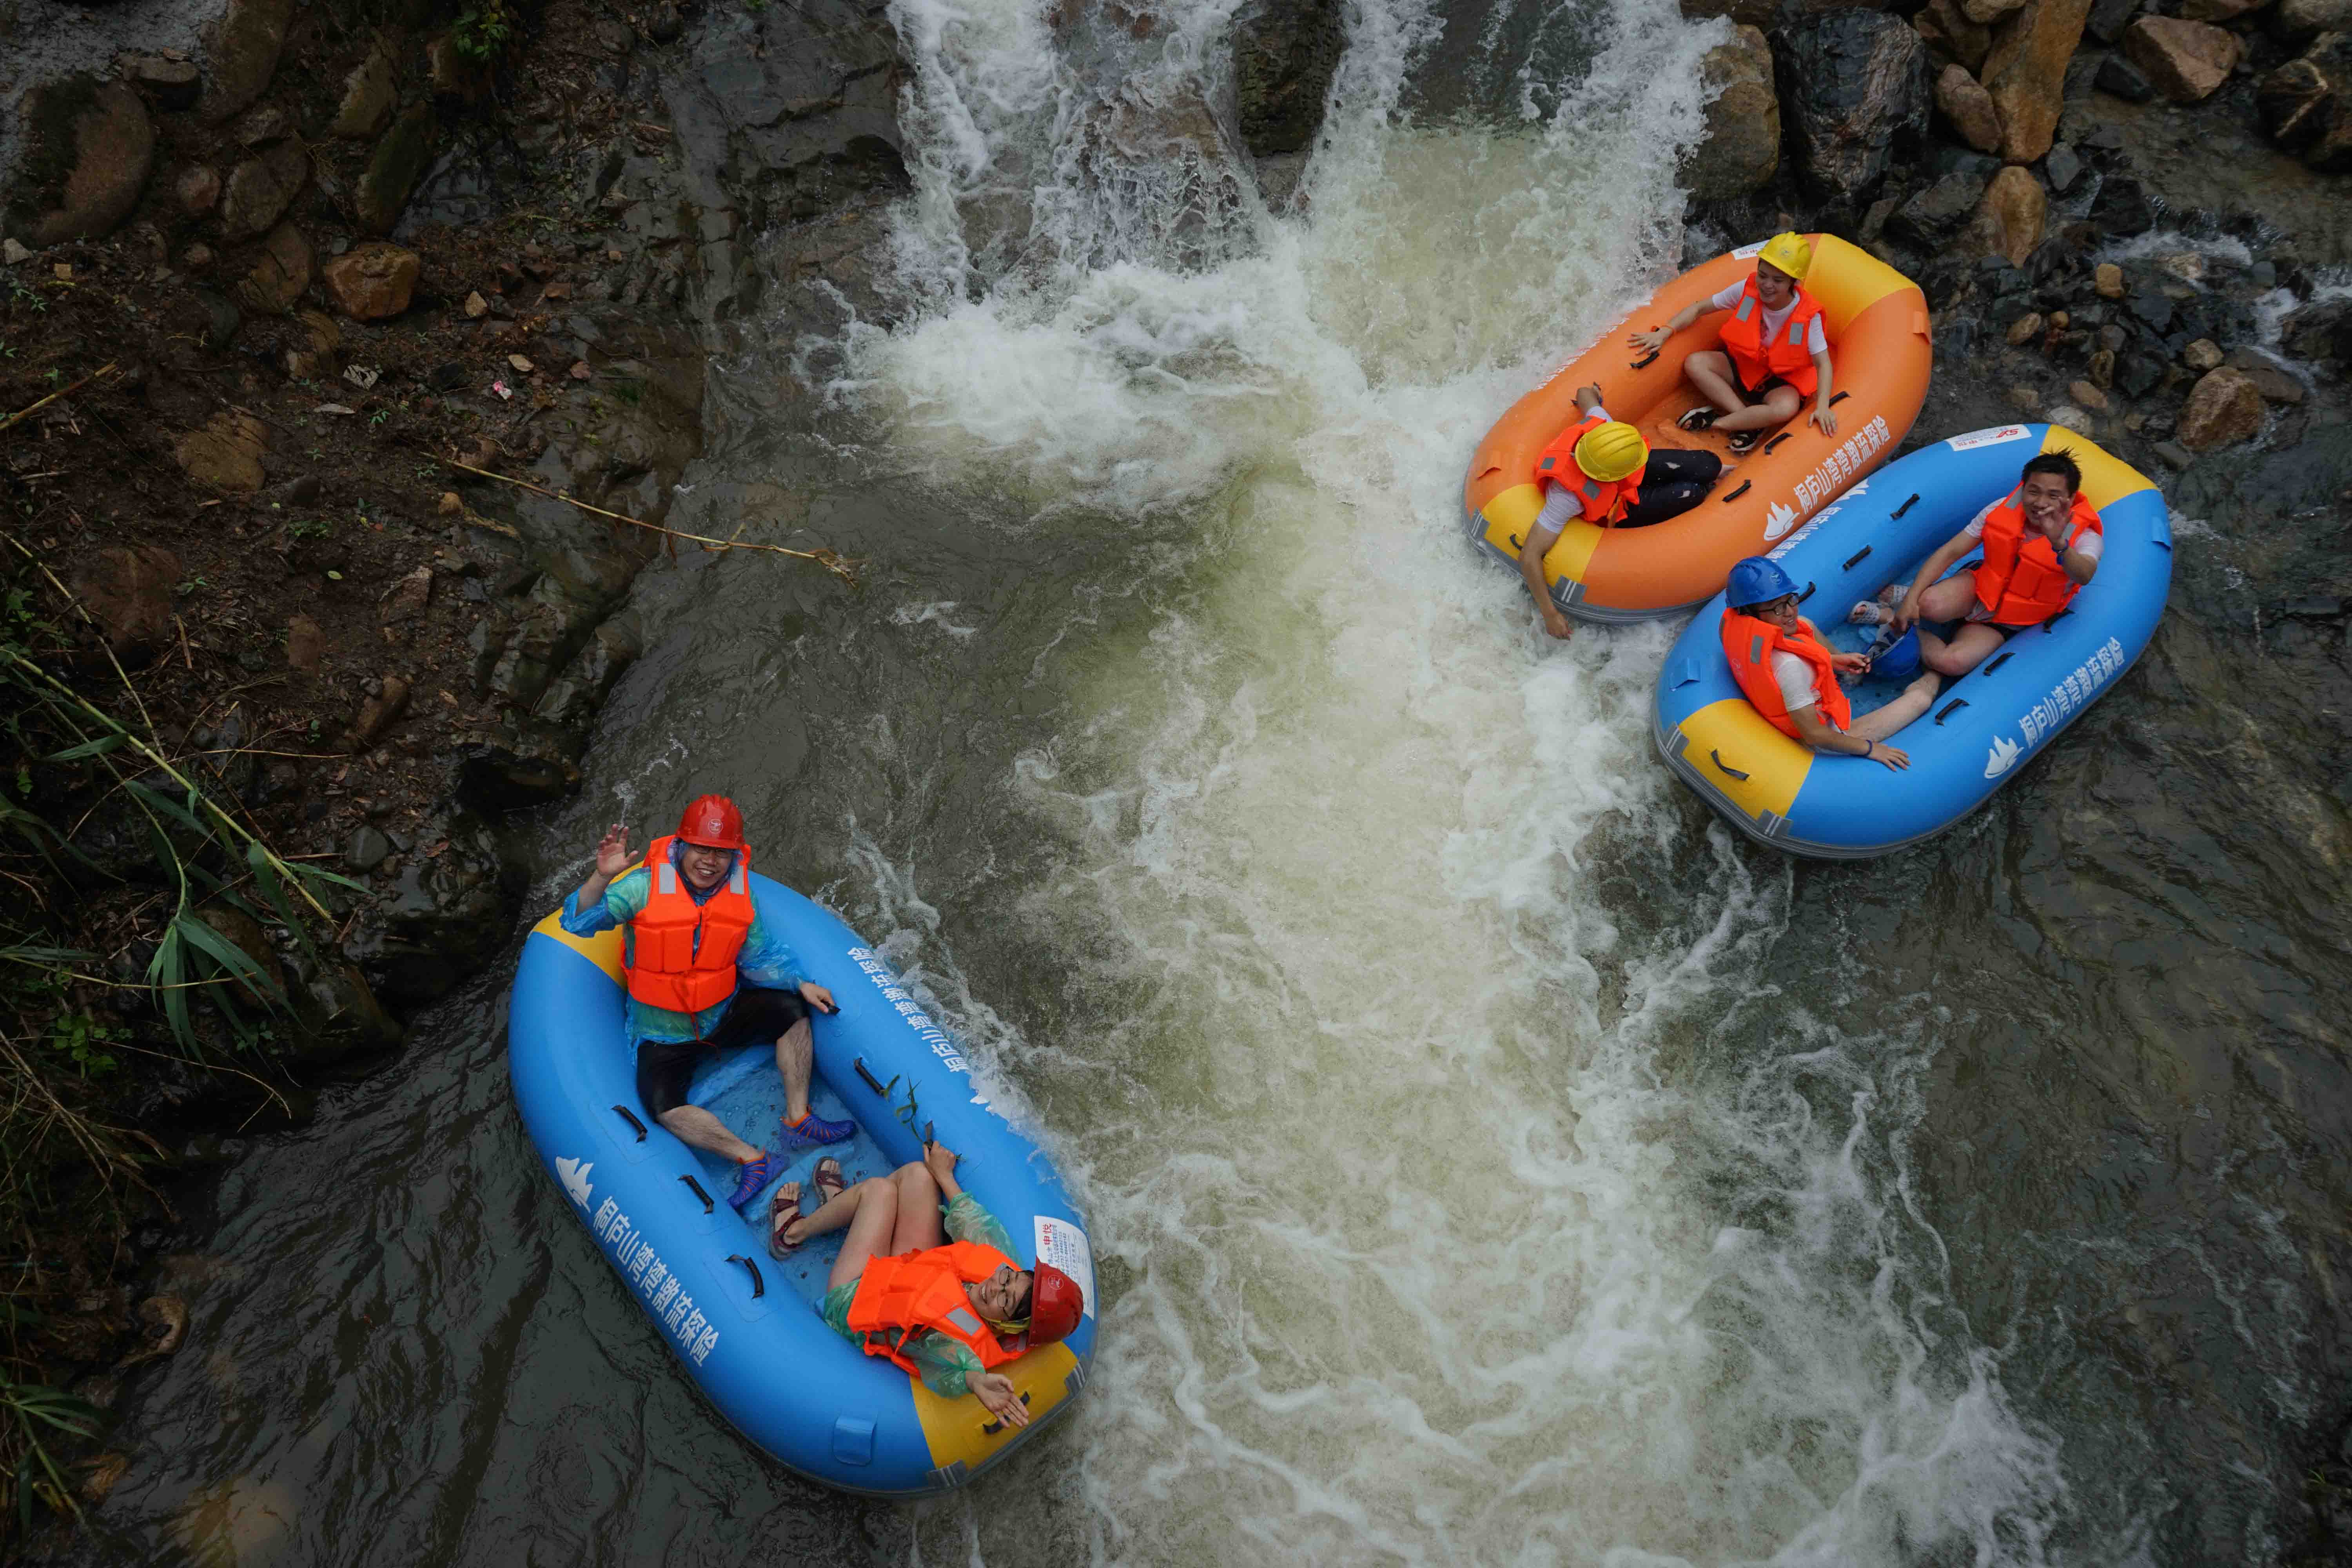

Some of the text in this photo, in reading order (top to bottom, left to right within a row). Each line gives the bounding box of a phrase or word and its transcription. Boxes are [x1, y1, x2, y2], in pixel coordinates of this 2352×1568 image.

[1793, 414, 1891, 514] 桐庐山湾湾激流探险
[2019, 636, 2125, 749] 桐庐山湾湾激流探险
[593, 1196, 720, 1367] 桐庐山湾湾激流探险
